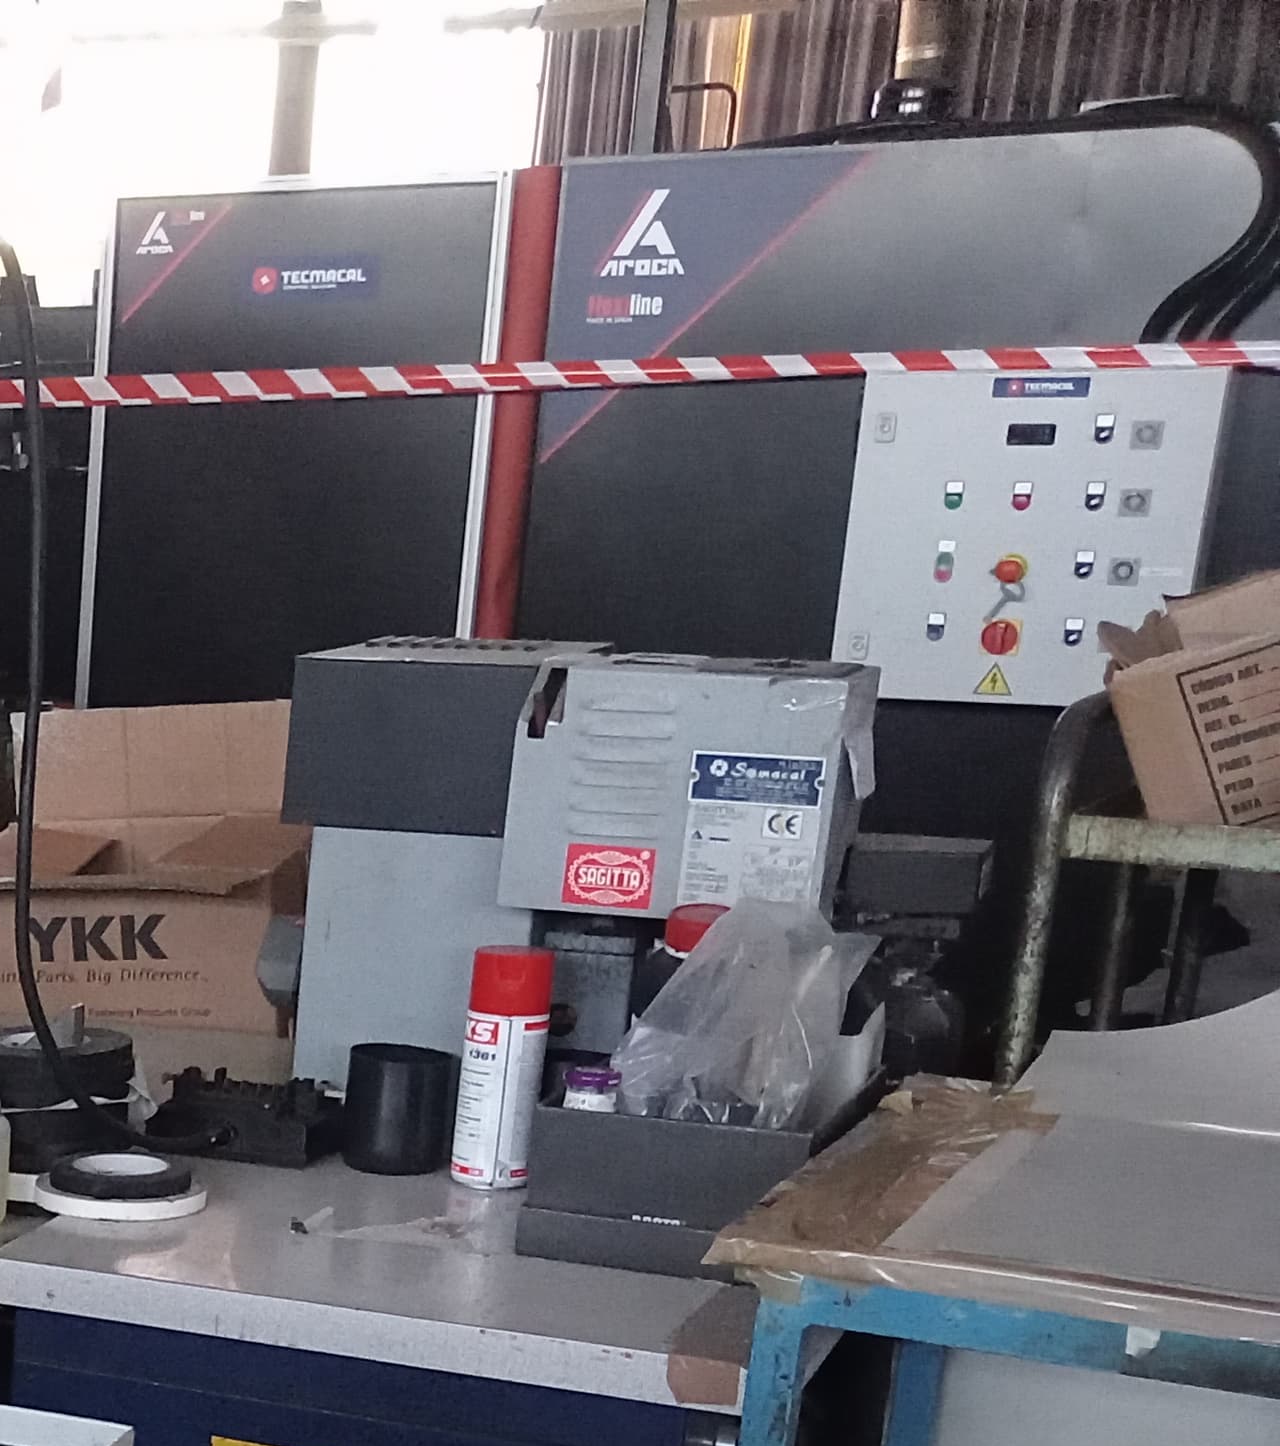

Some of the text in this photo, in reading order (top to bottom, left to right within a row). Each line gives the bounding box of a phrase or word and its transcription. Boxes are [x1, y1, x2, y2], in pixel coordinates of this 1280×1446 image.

[281, 268, 367, 284] TECMACAL
[600, 257, 685, 277] AROCA
[577, 867, 641, 889] SAGITTA
[29, 914, 169, 962] YKK
[86, 970, 112, 985] Big
